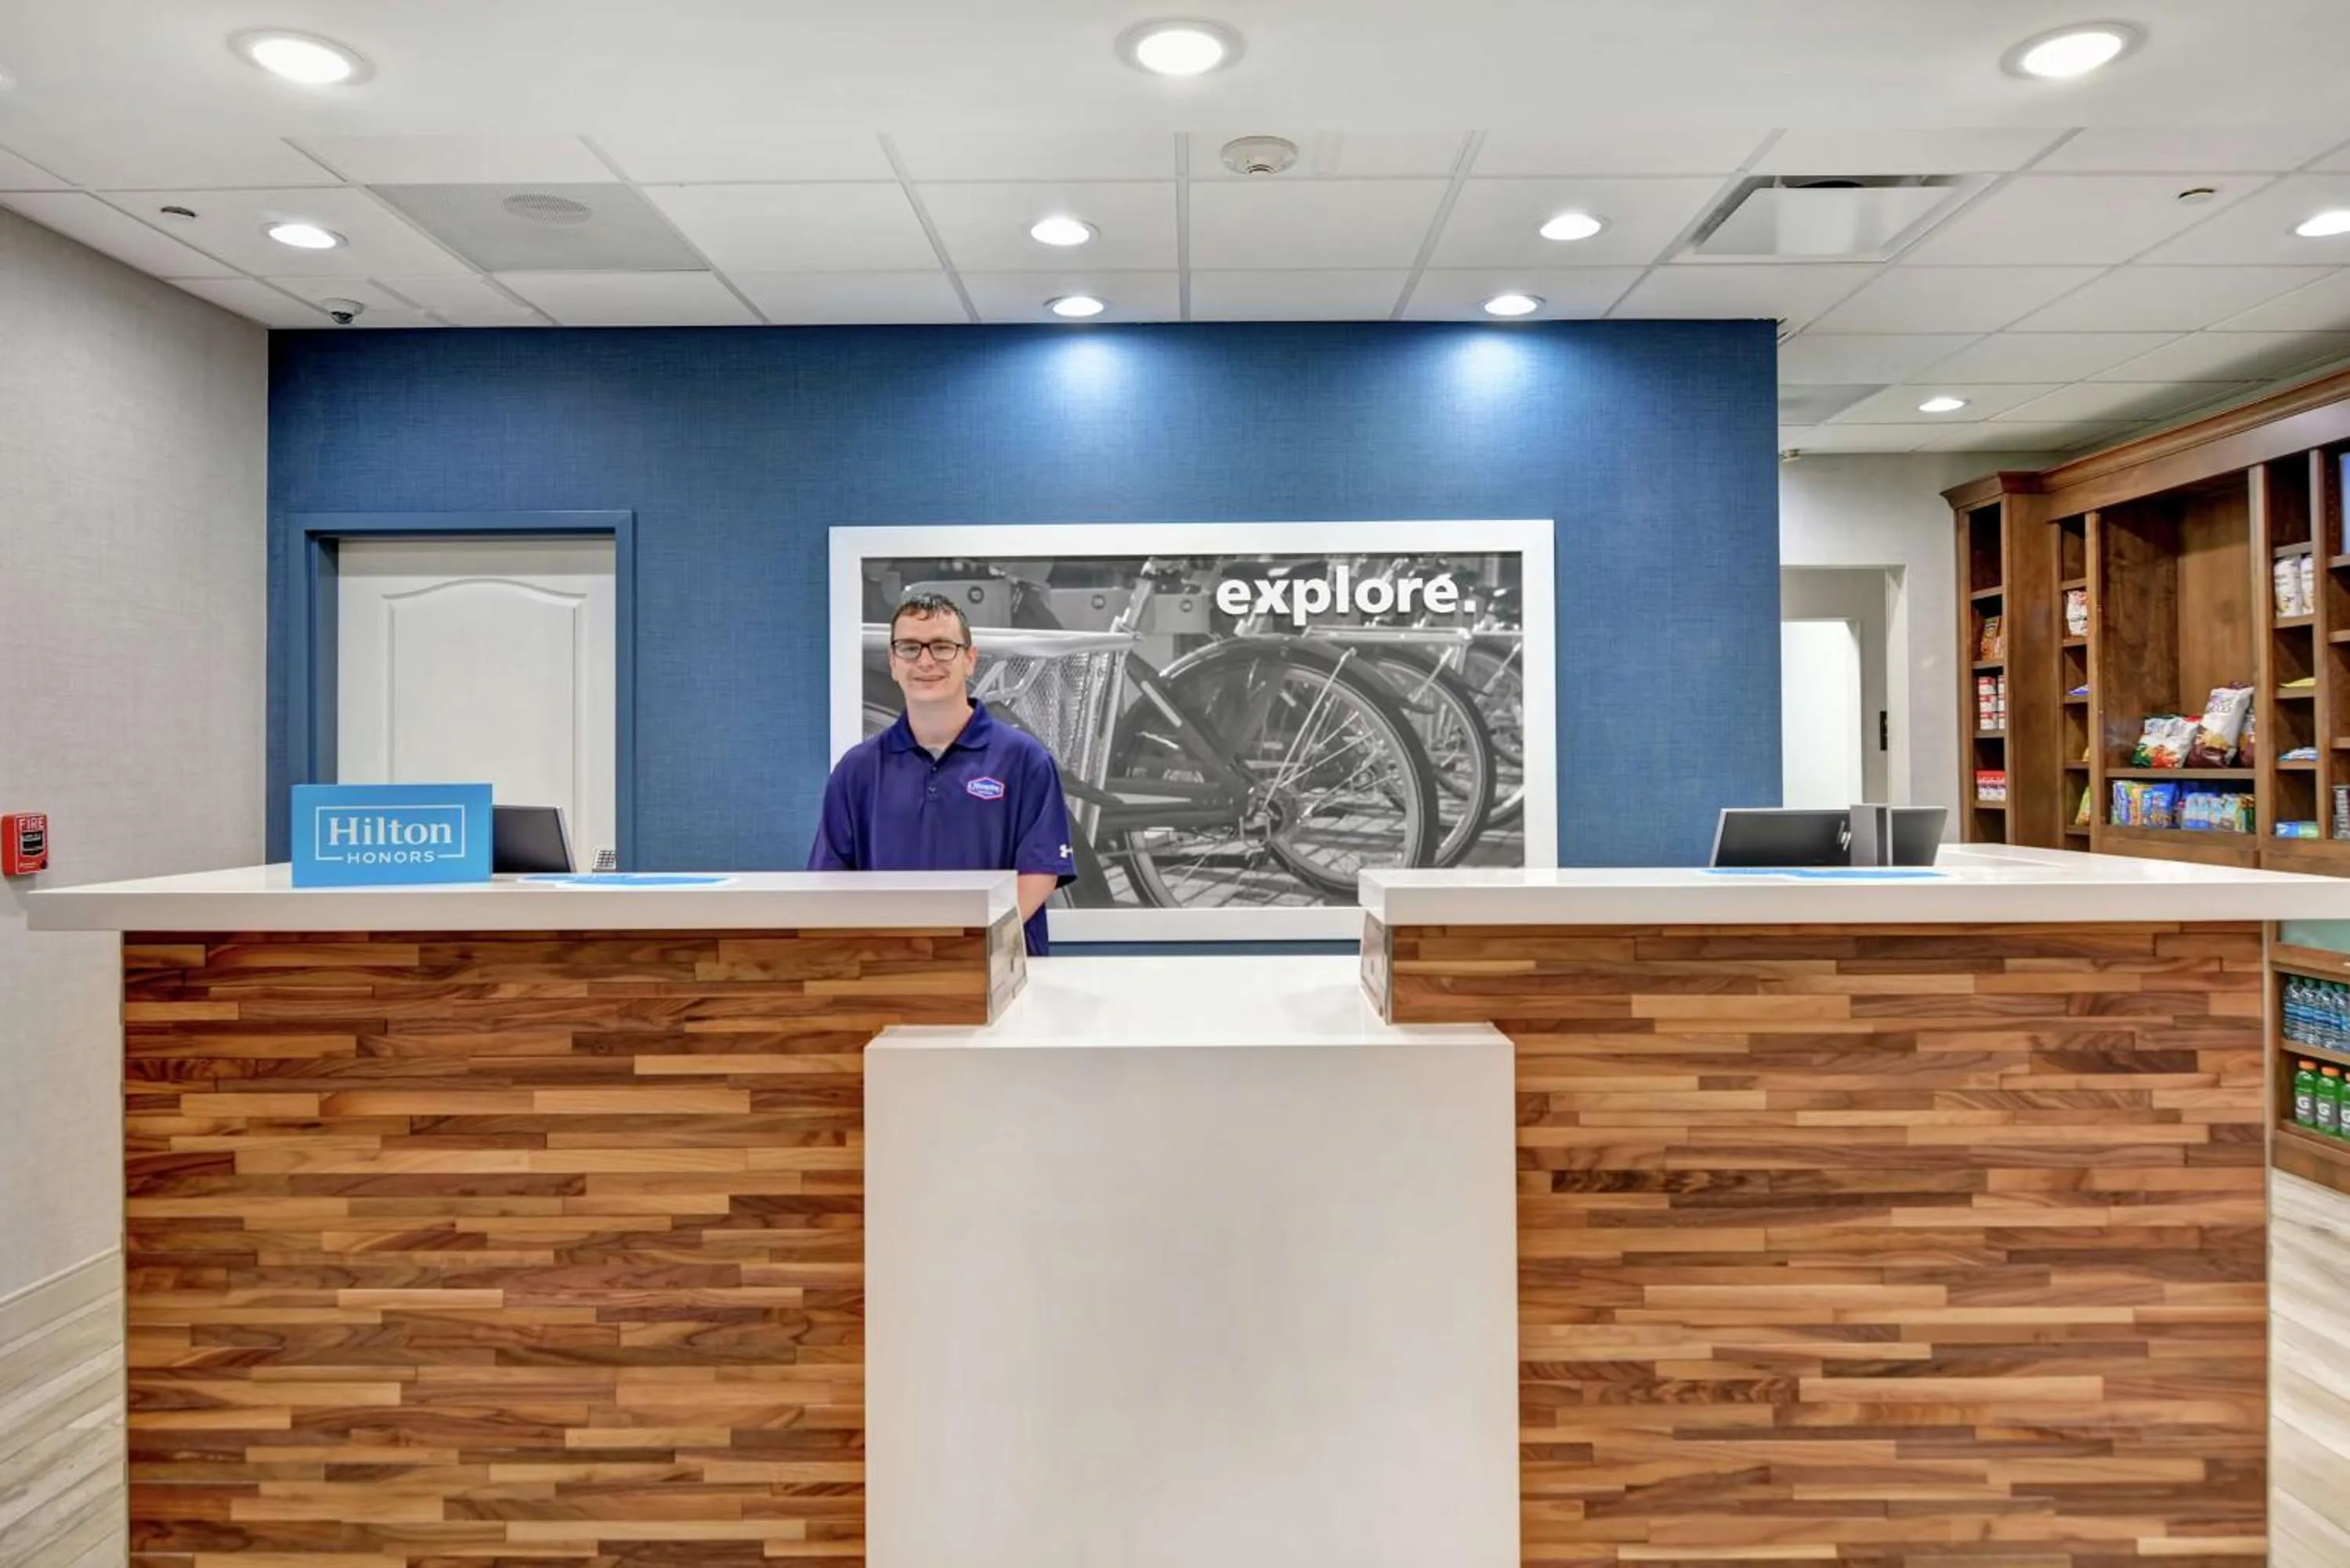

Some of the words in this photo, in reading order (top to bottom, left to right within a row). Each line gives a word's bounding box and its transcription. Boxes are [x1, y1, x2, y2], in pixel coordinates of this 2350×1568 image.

[1216, 565, 1477, 627] explore.
[18, 817, 45, 830] FIRE
[328, 816, 452, 846] Hilton
[347, 851, 436, 865] HONORS
